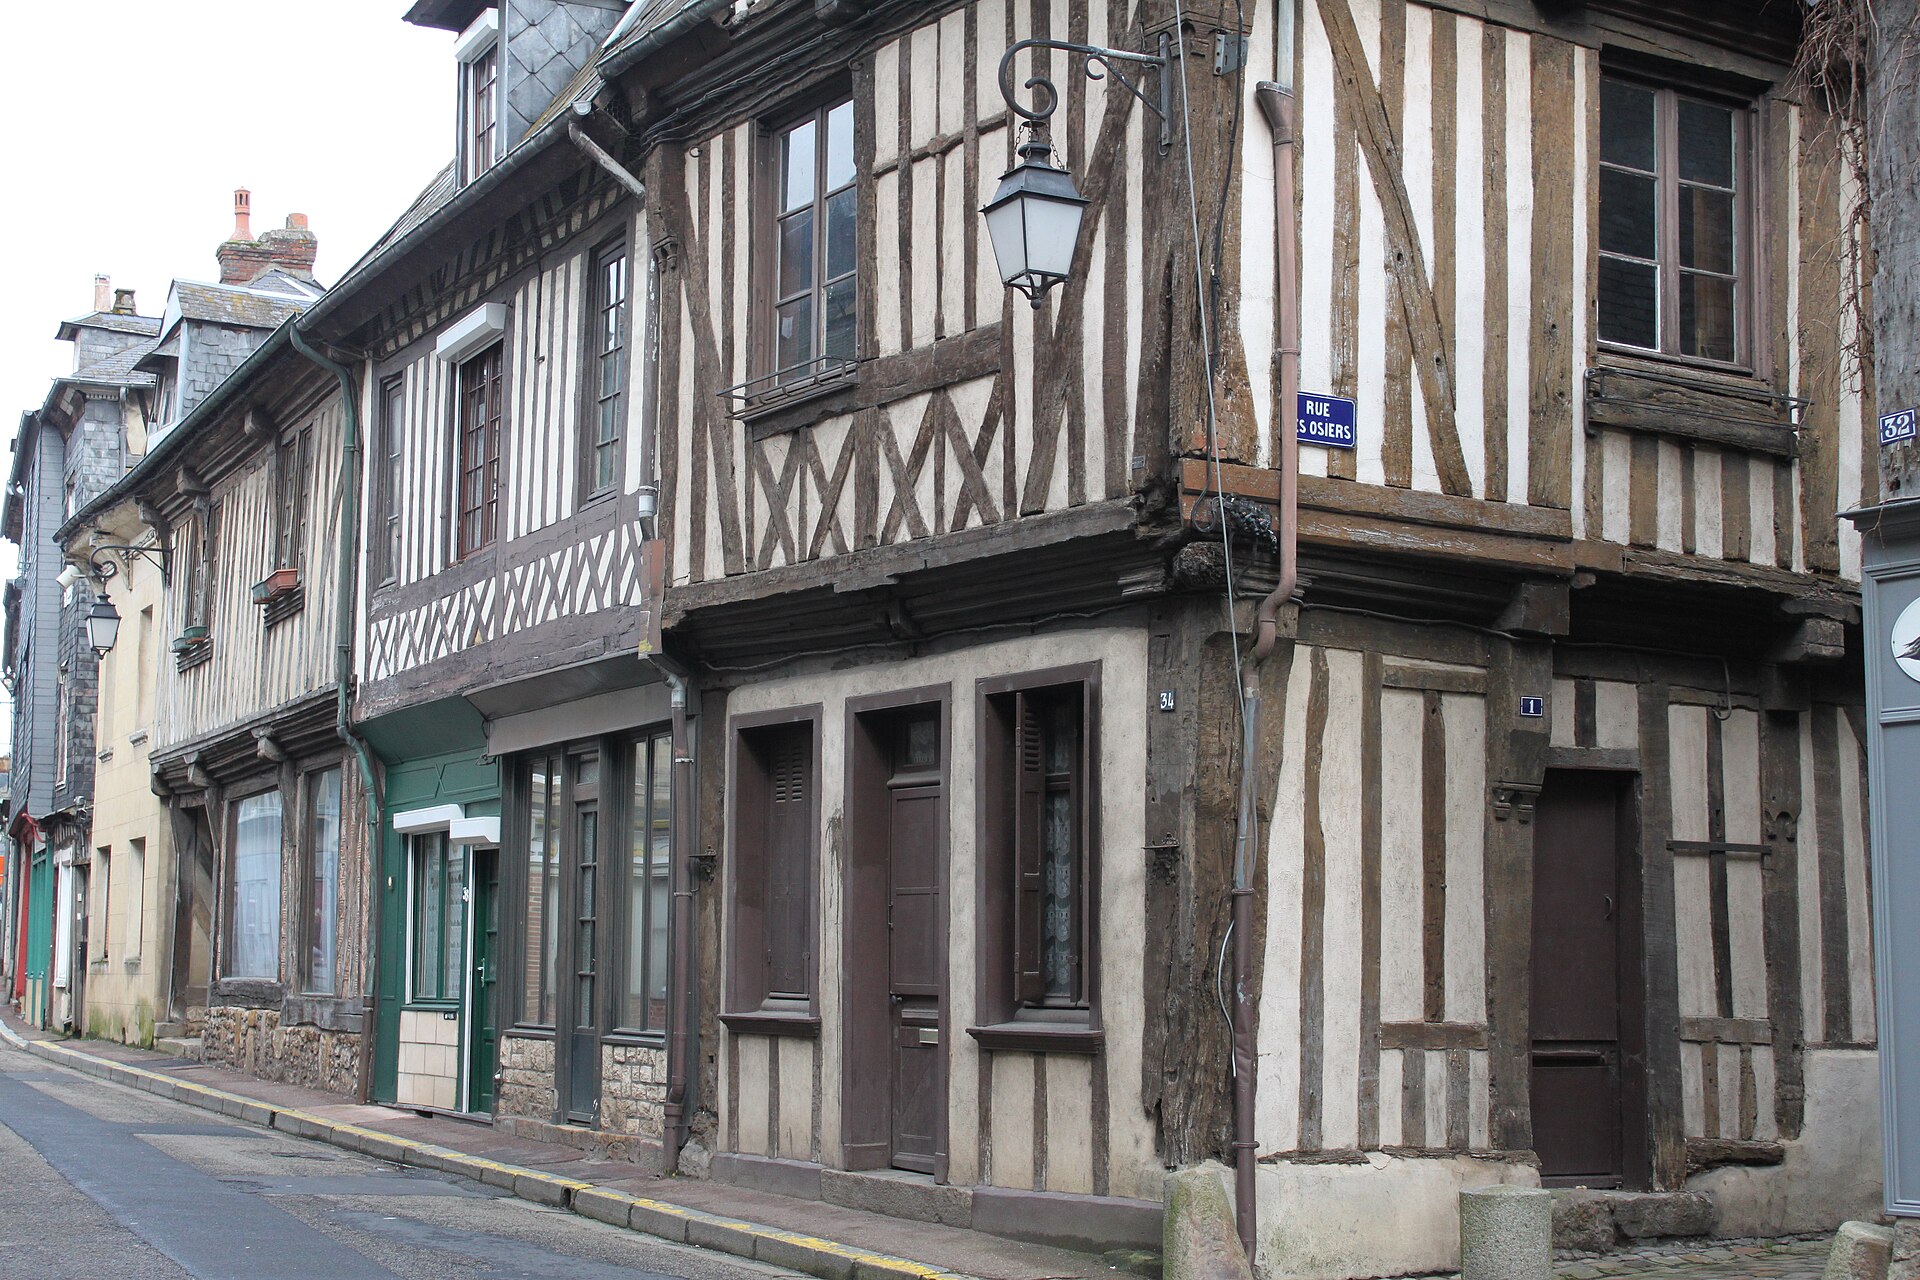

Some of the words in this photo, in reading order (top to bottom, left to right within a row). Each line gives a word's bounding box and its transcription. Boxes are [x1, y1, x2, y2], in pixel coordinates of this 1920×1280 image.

[1306, 400, 1331, 417] RUE
[1309, 421, 1352, 440] OSIERS
[1884, 415, 1910, 438] 32
[1160, 692, 1174, 709] 34
[1529, 699, 1535, 714] 1
